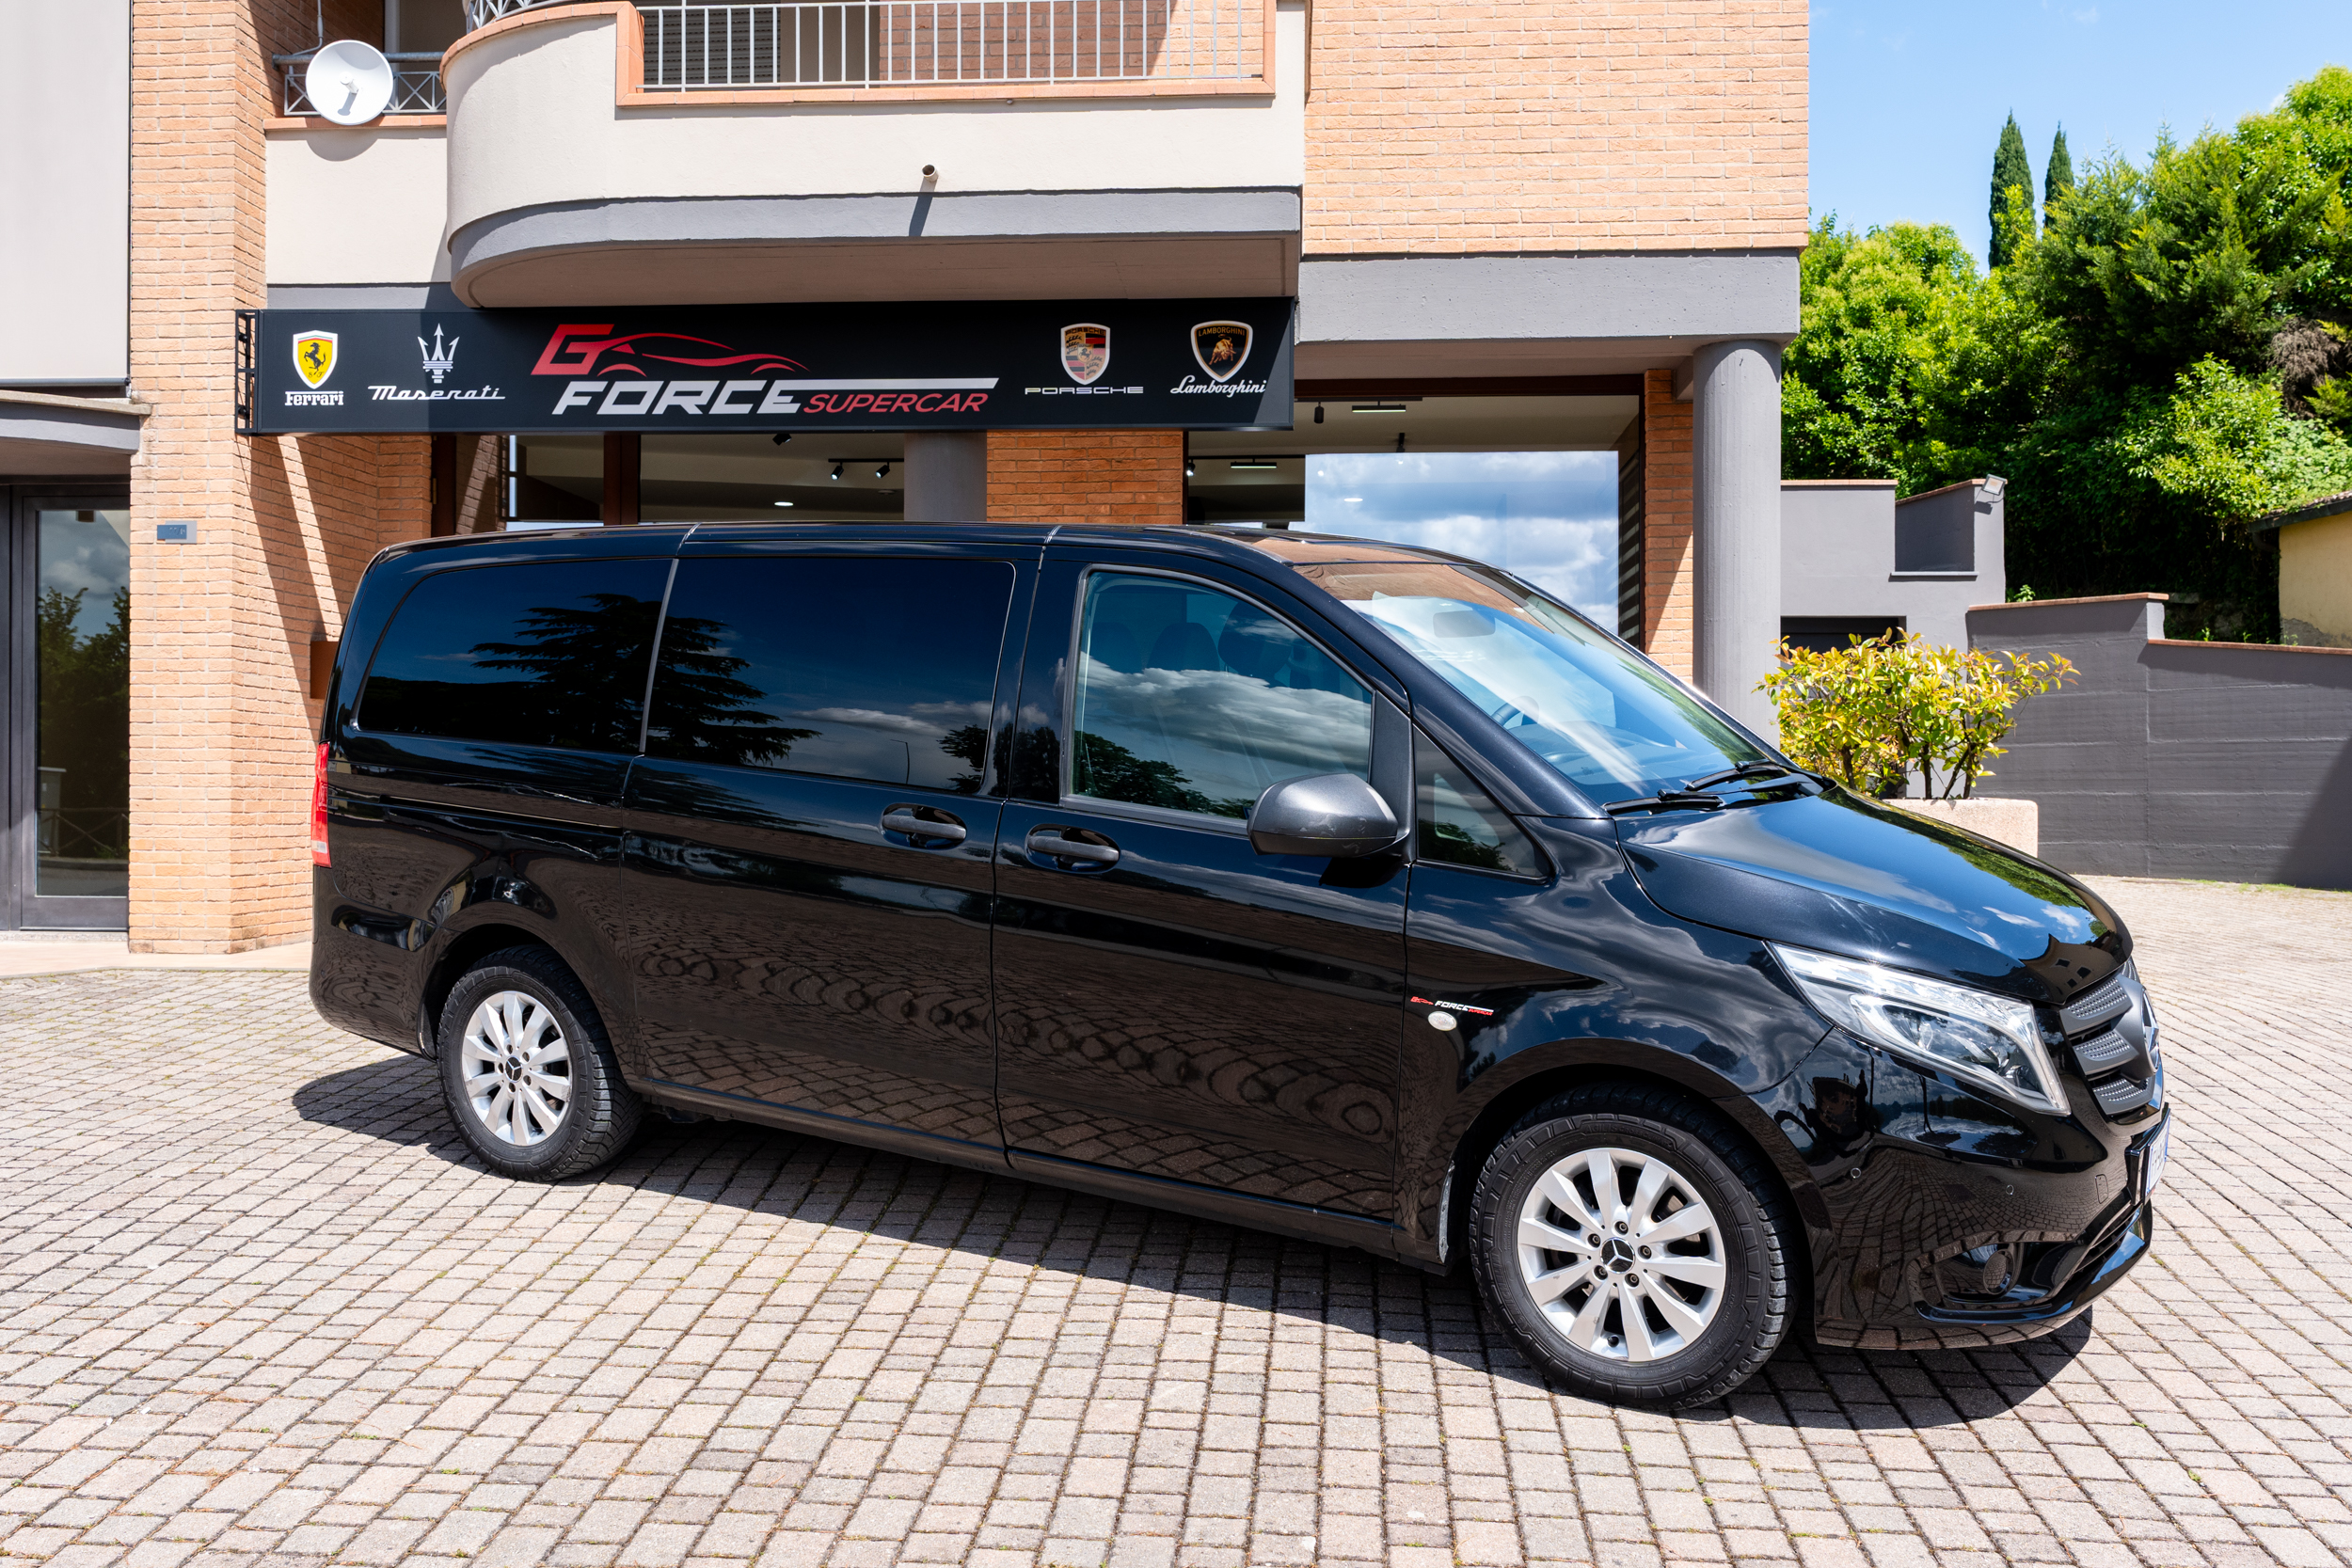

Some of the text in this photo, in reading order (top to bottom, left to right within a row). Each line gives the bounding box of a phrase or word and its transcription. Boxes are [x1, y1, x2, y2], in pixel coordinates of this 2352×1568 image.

[1065, 326, 1105, 336] PORSCHE
[1198, 326, 1246, 337] LAMBORGHINI
[367, 385, 506, 401] Maserati
[1025, 386, 1144, 395] PORSCHE
[1169, 374, 1267, 399] Lamborghini
[284, 390, 344, 406] Ferrari
[551, 378, 989, 415] FORCE SUPERCAR
[1434, 1000, 1470, 1011] FORCE
